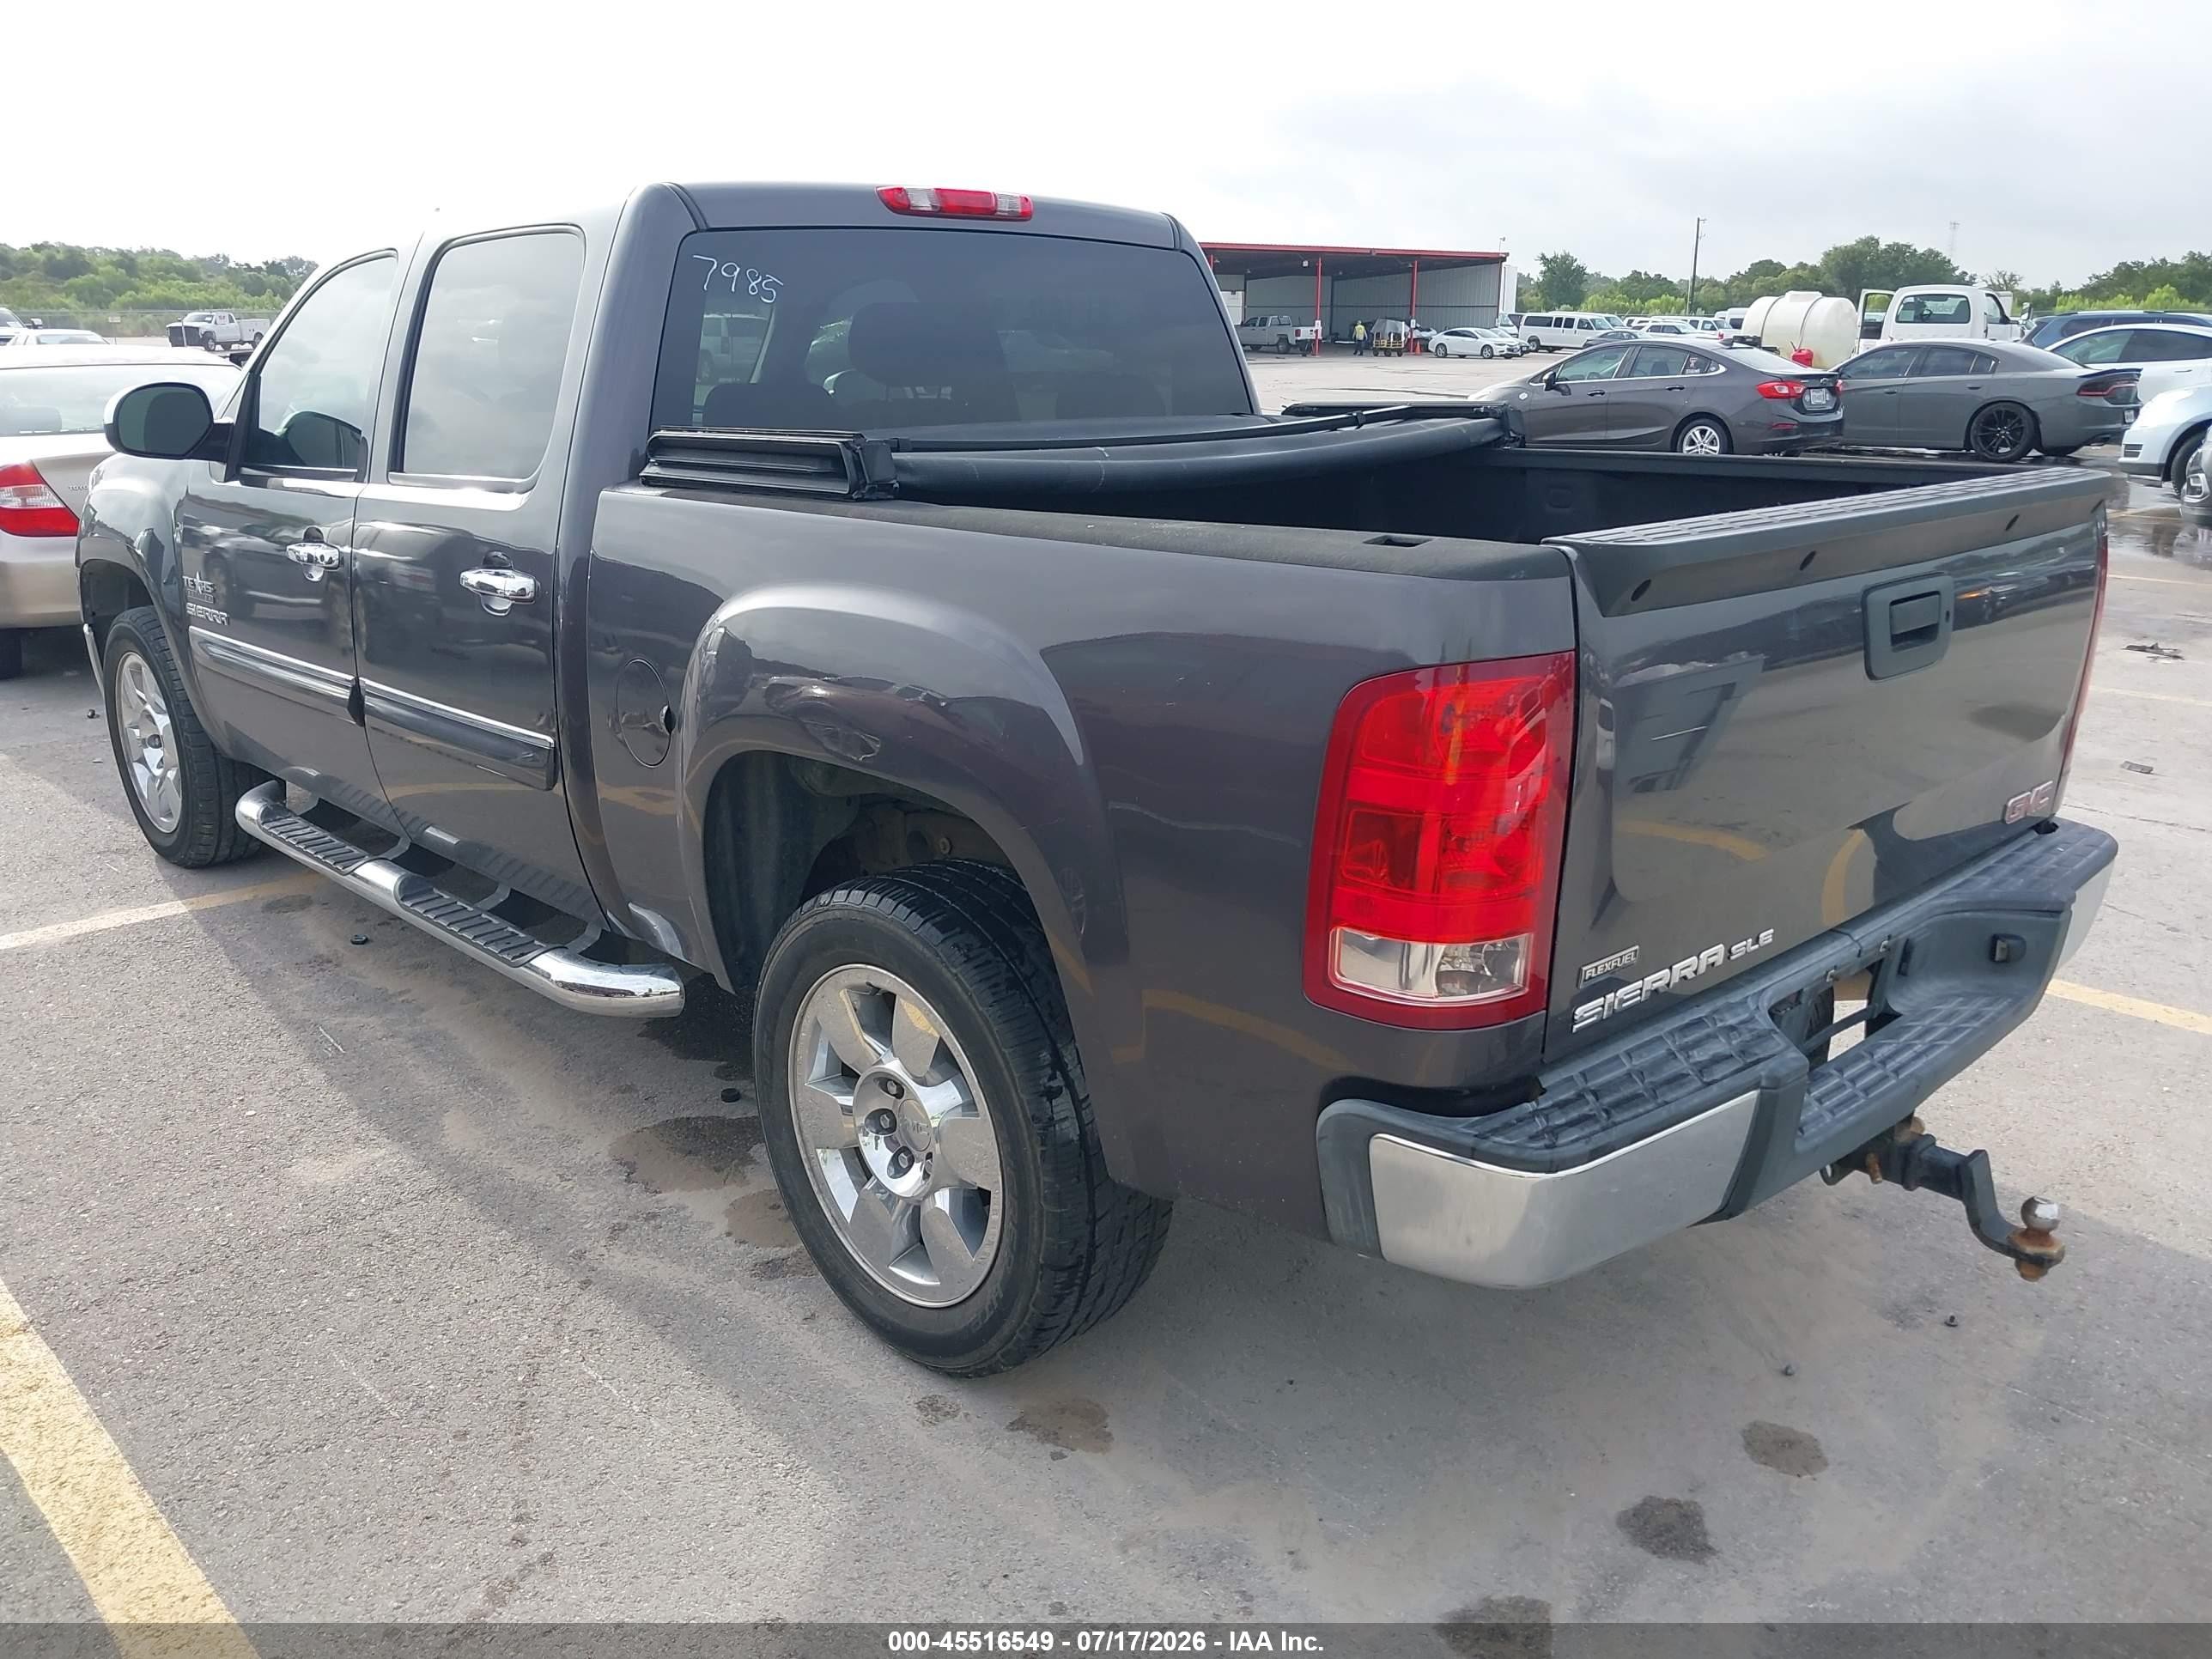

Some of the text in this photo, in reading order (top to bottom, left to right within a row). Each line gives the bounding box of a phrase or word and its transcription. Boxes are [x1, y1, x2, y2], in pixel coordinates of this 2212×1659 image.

[693, 254, 784, 303] 7985
[186, 602, 228, 626] SIERRA
[1572, 928, 1774, 1034] SIERRA SLE
[1585, 951, 1637, 981] FLEXFUEL
